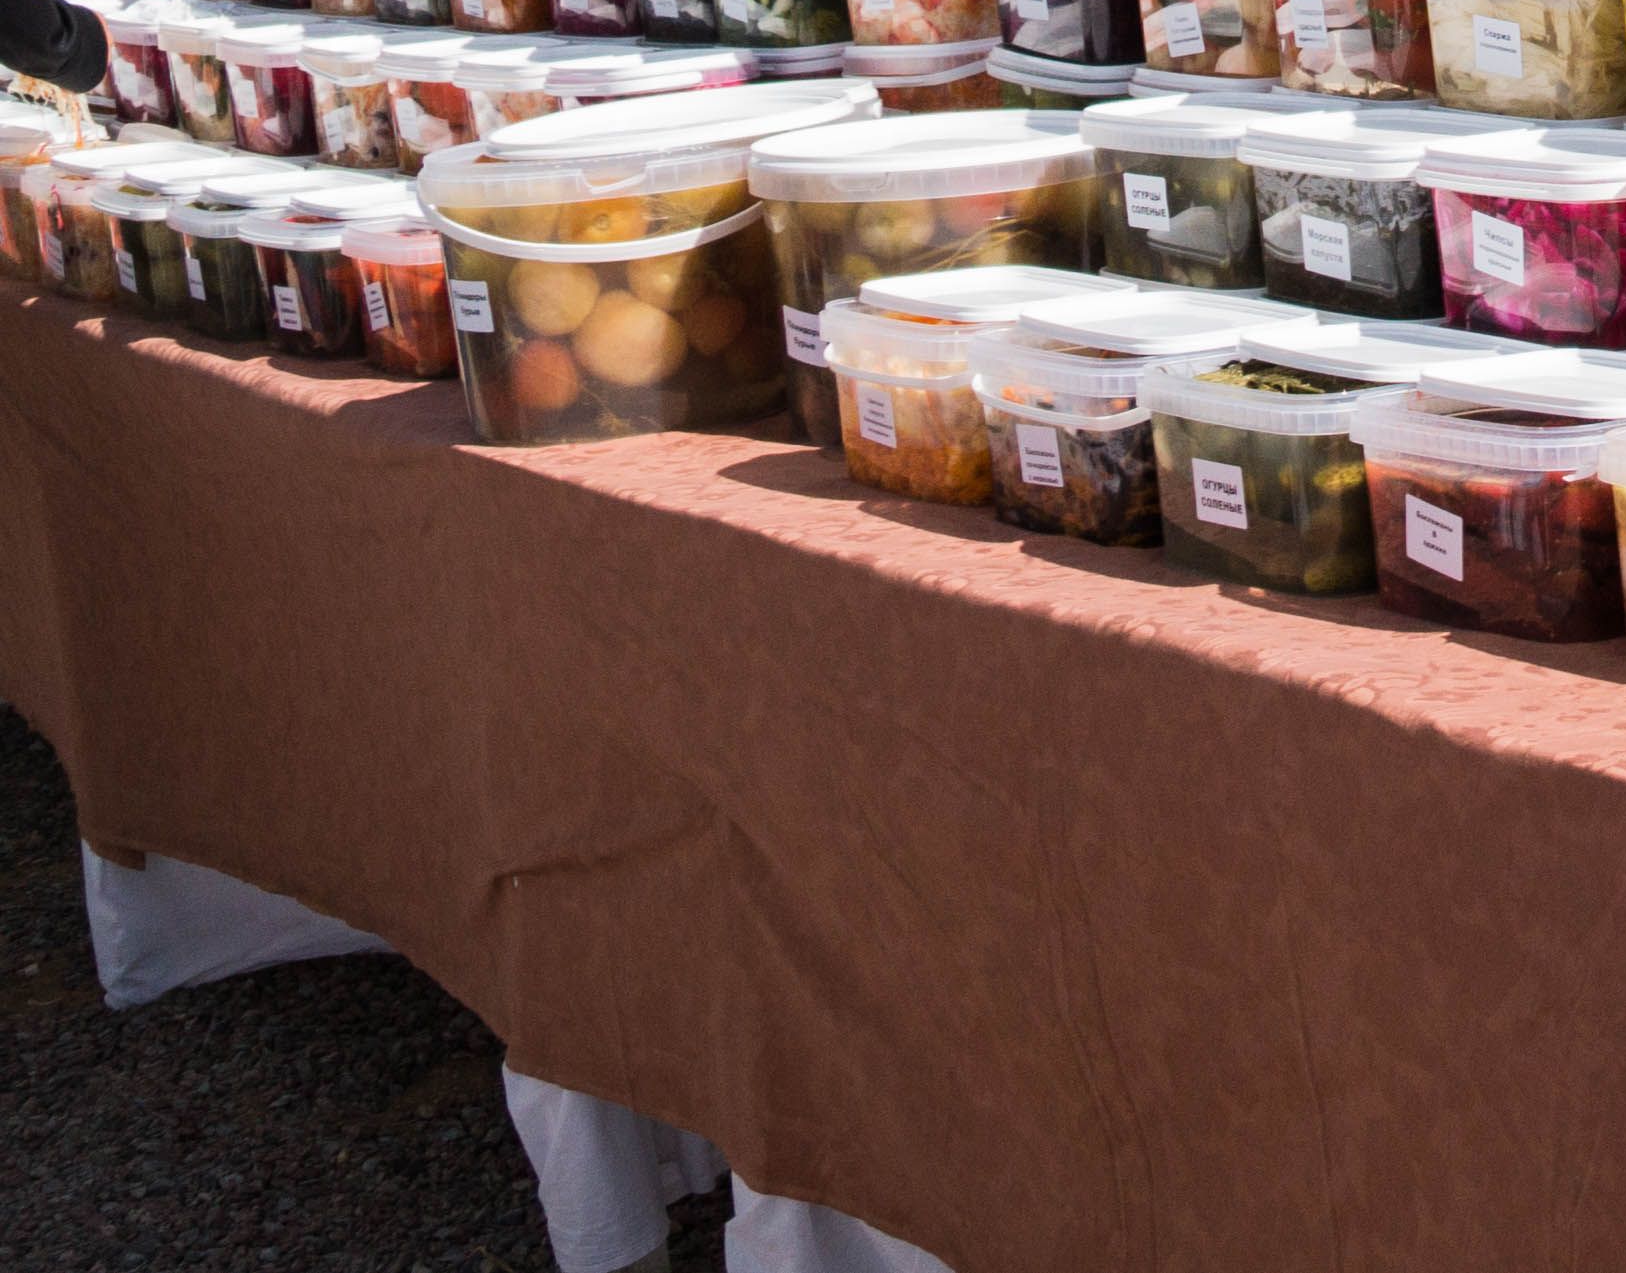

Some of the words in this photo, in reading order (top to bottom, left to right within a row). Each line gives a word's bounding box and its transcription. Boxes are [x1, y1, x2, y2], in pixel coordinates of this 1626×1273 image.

[1308, 228, 1343, 245] Морская
[1311, 248, 1343, 263] капуста
[1202, 478, 1237, 496] ОГУРЦЫ
[1201, 496, 1243, 515] СОЛЕНЫЕ
